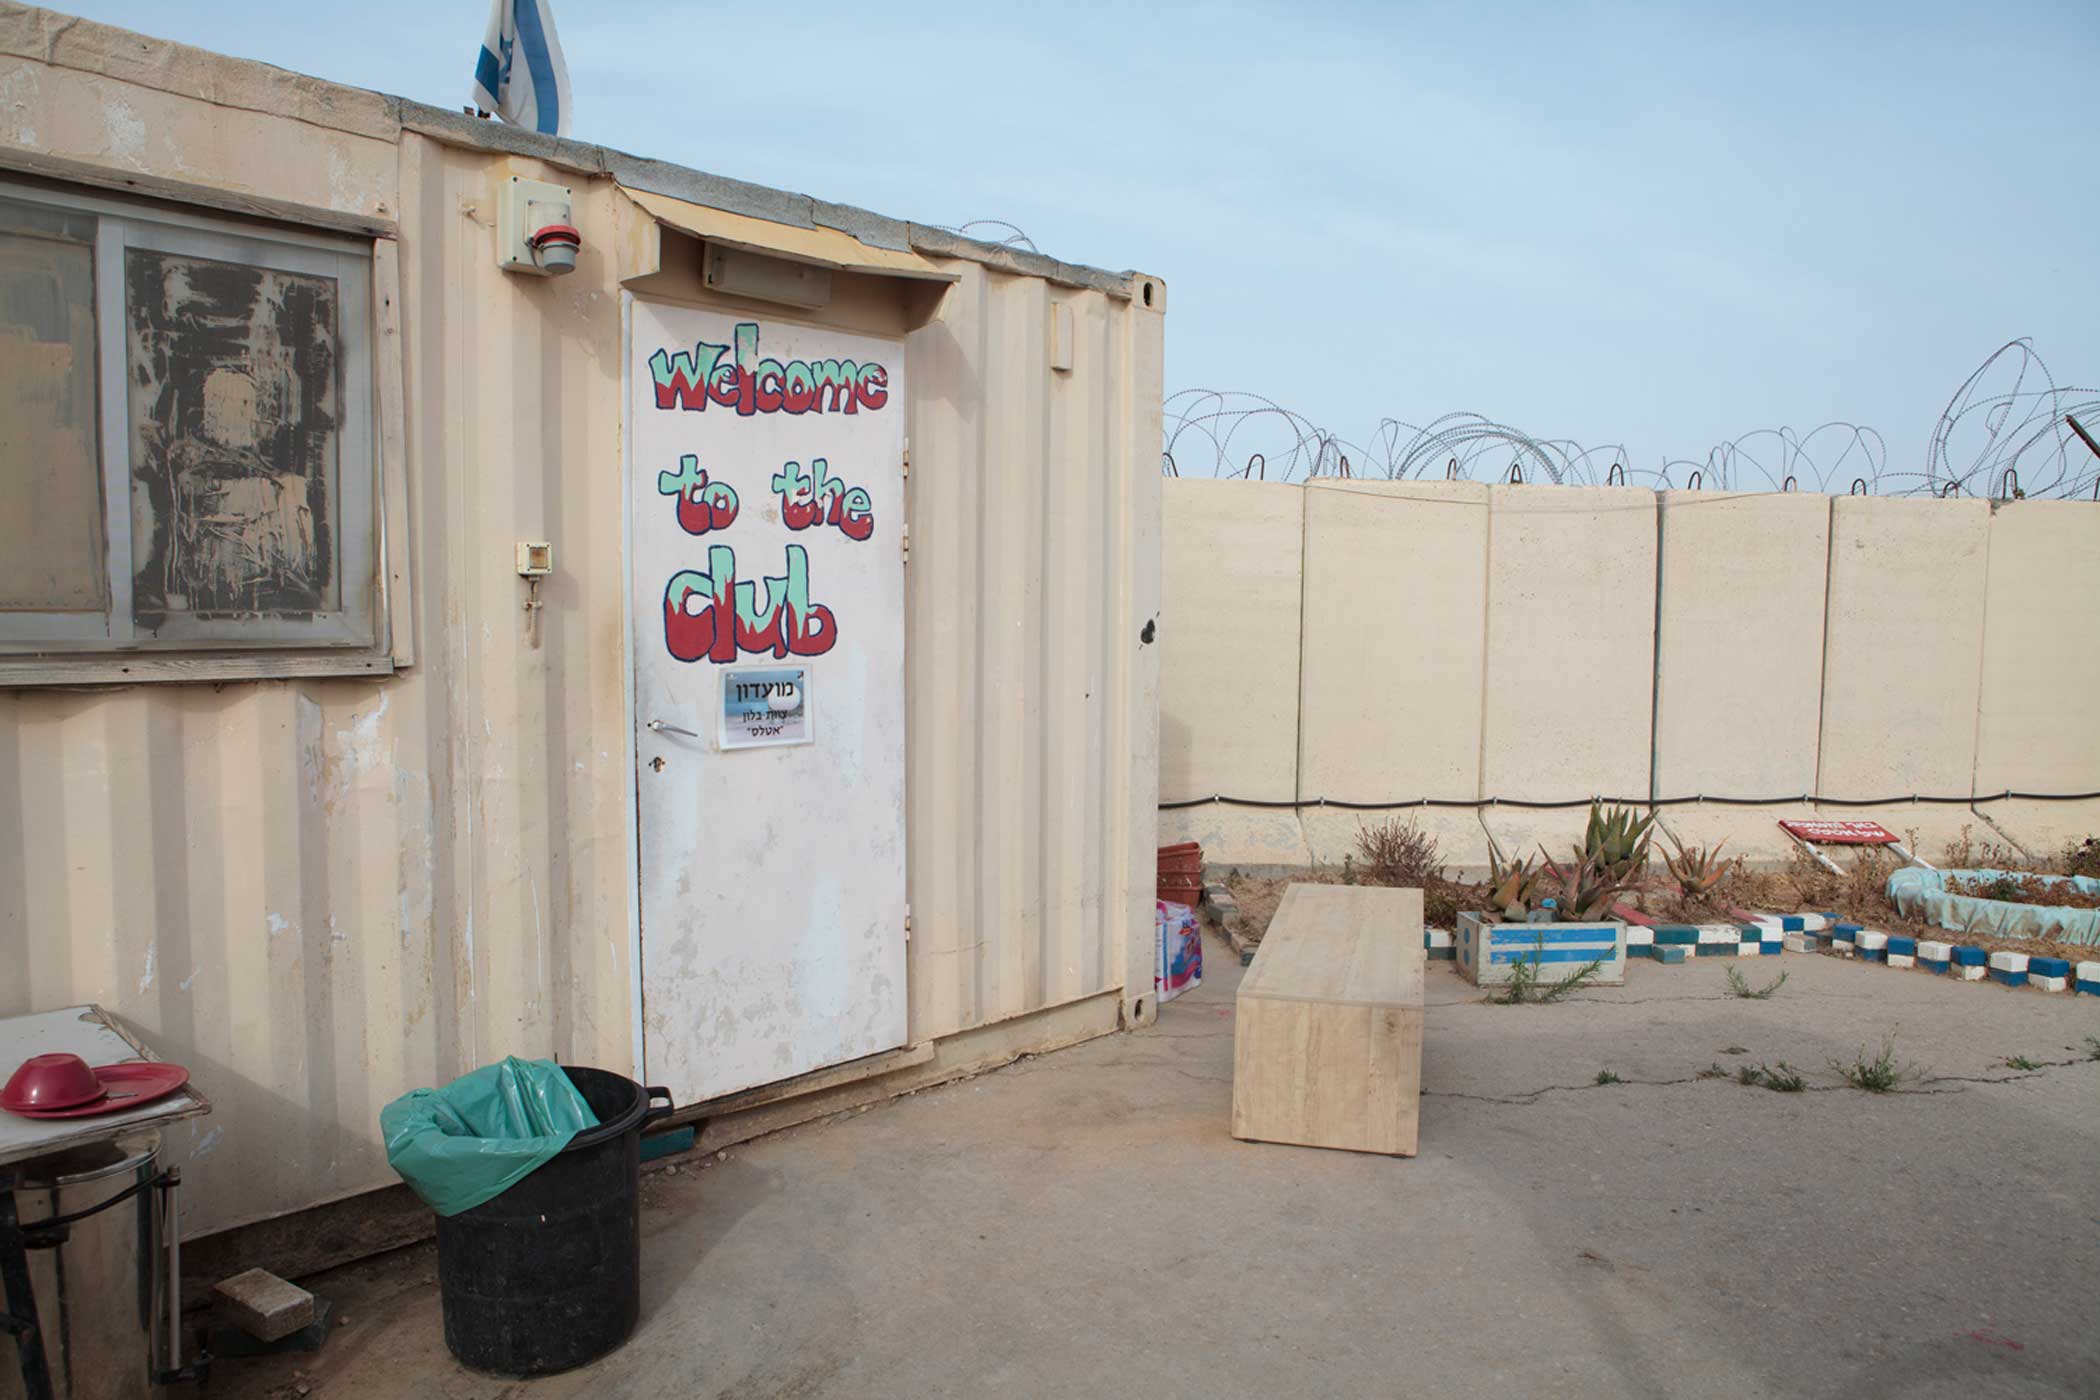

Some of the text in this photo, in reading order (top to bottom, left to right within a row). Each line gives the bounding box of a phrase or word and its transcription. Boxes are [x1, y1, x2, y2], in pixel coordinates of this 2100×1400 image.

[658, 454, 874, 541] to the
[736, 681, 794, 702] מועדון
